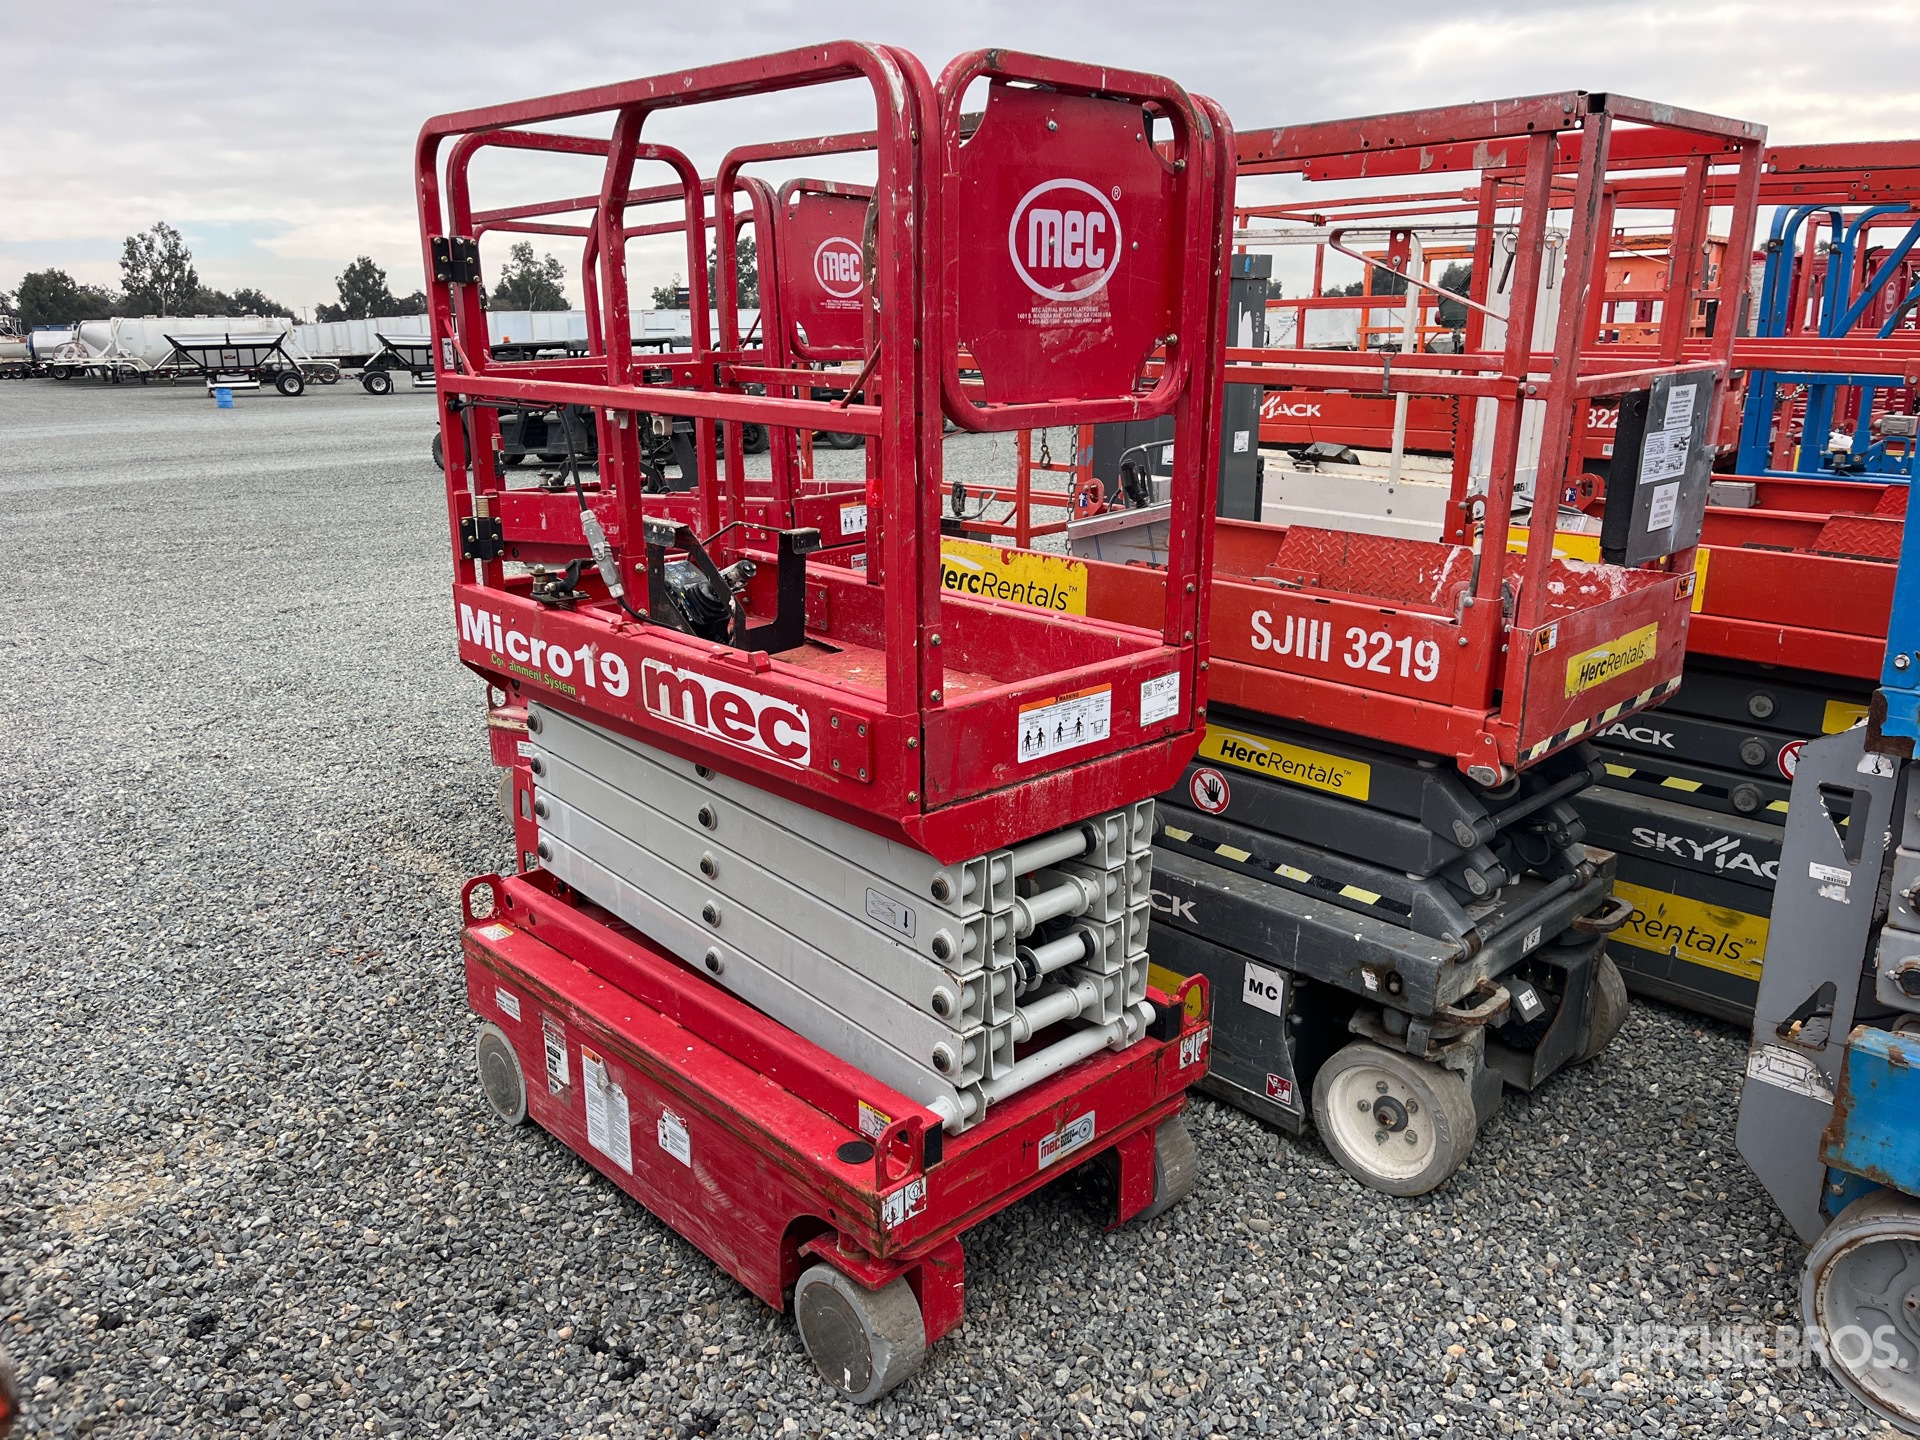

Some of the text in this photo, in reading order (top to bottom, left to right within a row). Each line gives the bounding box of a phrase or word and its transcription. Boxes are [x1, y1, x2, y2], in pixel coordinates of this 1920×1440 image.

[1028, 208, 1105, 268] mec
[822, 251, 860, 282] mec
[460, 603, 629, 697] Micro19
[1251, 610, 1440, 682] SJIII 3219
[1580, 640, 1645, 685] HercRentals
[544, 673, 576, 696] System
[645, 664, 809, 759] mec
[1220, 739, 1344, 787] HercRentals
[1249, 978, 1278, 1001] MC
[1041, 1138, 1060, 1159] mec
